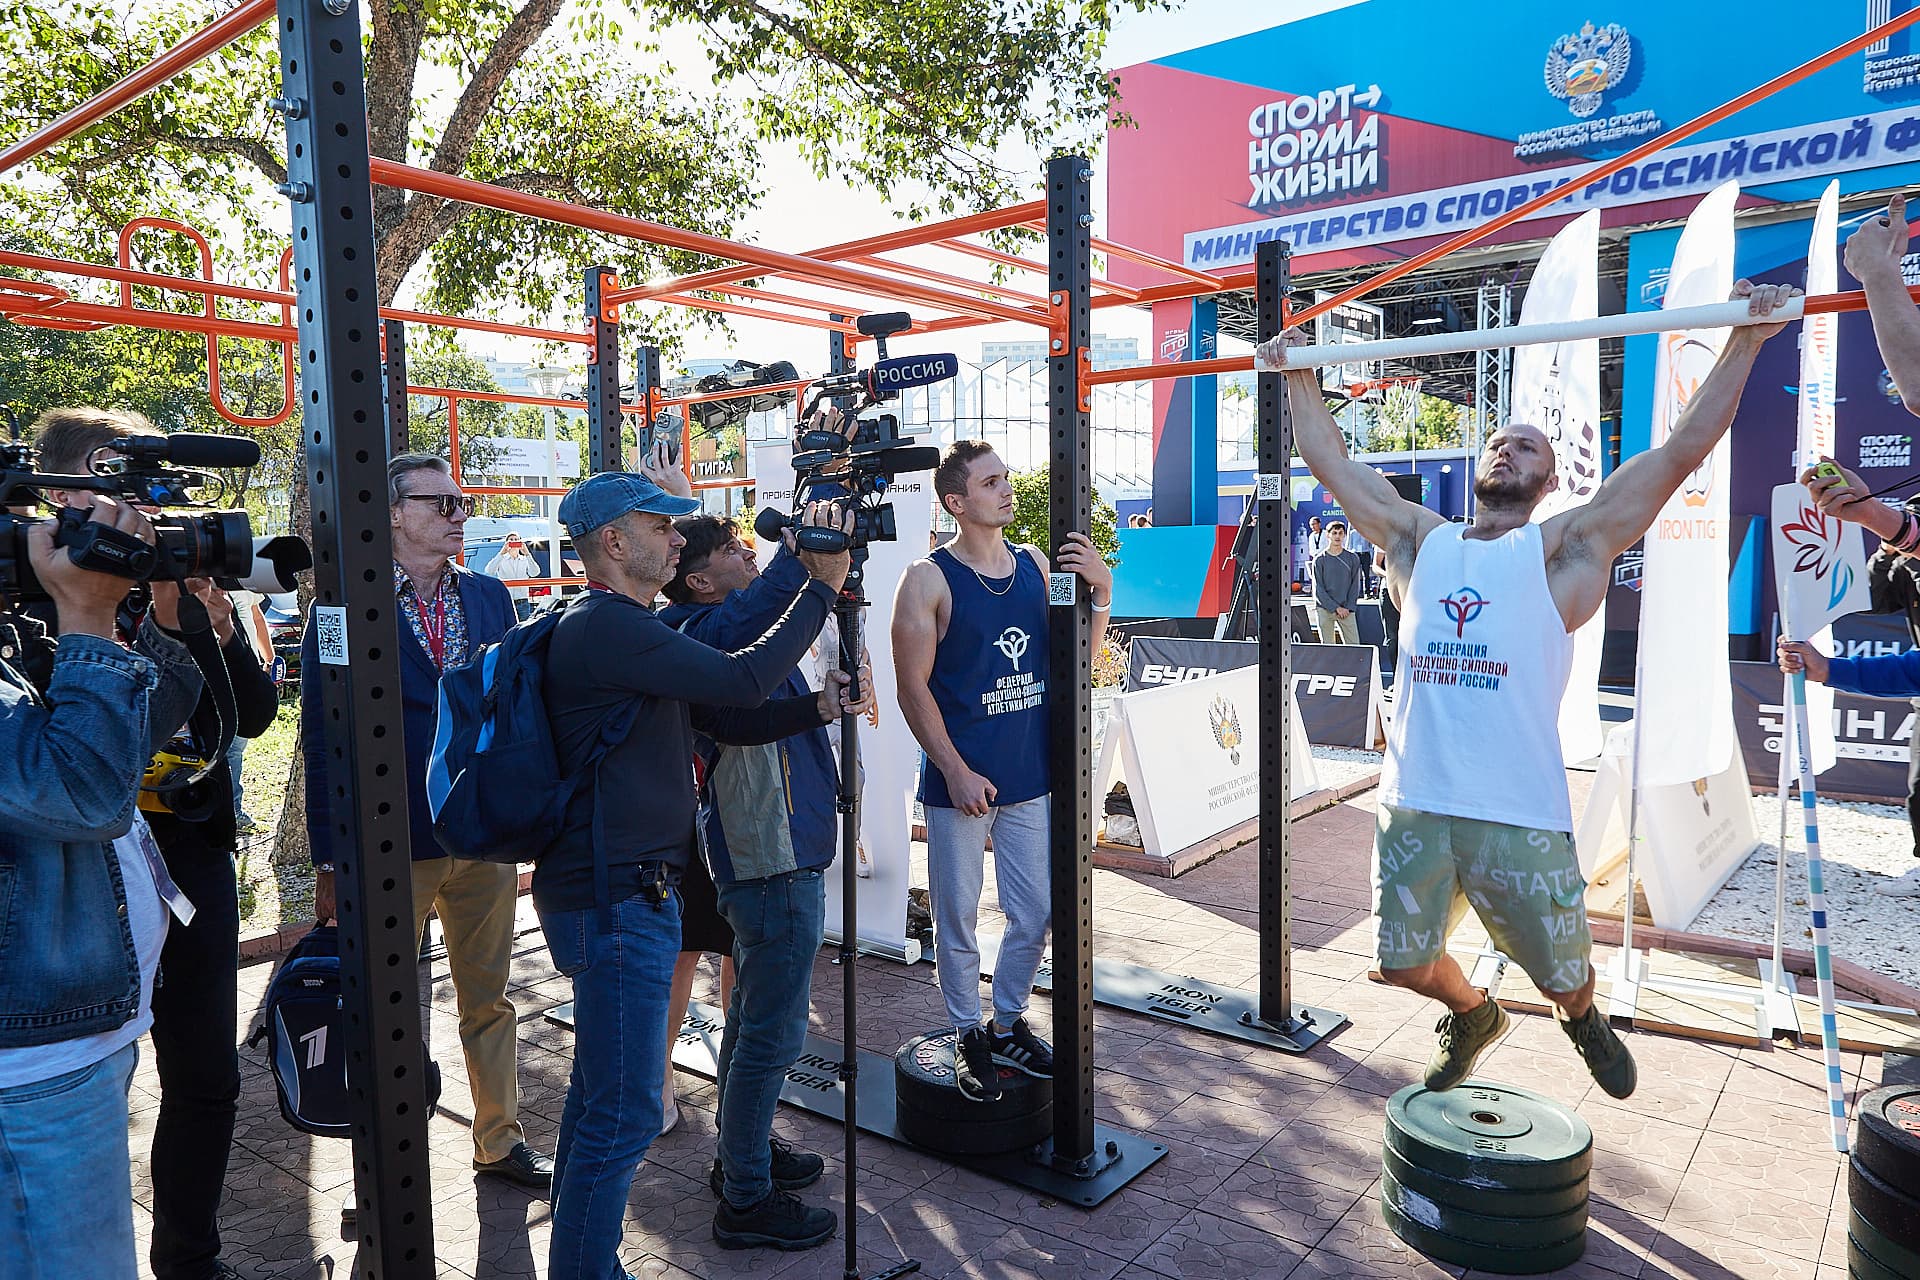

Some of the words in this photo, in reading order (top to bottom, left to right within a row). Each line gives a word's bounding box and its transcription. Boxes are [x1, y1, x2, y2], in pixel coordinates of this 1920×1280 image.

[1249, 84, 1356, 138] СПОРТ
[1519, 119, 1606, 145] МИНИСТЕРСТВО
[1609, 110, 1656, 128] СПОРТА
[1249, 114, 1379, 173] НОРМА
[1514, 133, 1590, 157] РОССИЙСКОЙ
[1591, 120, 1661, 142] ФЕДЕРАЦИИ
[1585, 118, 1872, 199] РОССИЙСКОЙ
[1248, 150, 1378, 207] ЖИЗНИ
[878, 360, 946, 384] РОССИЯ
[1860, 435, 1904, 447] СПОРТ
[1860, 445, 1911, 457] НОРМА
[698, 460, 735, 475] ТИГРА
[1859, 455, 1911, 468] ЖИЗНИ
[762, 490, 796, 500] ПРОИЗ
[887, 483, 921, 494] АНИЯ
[1659, 519, 1692, 540] IRON
[98, 544, 127, 559] SONY
[1620, 564, 1642, 581] ГТ
[1428, 641, 1488, 659] ФЕДЕРАЦИЯ
[1413, 669, 1457, 686] АТЛЕТИКИ
[1459, 673, 1500, 691] РОССИИ
[1145, 992, 1212, 1015] TIGER
[1161, 984, 1223, 1004] IRON
[785, 1067, 837, 1092] IGER
